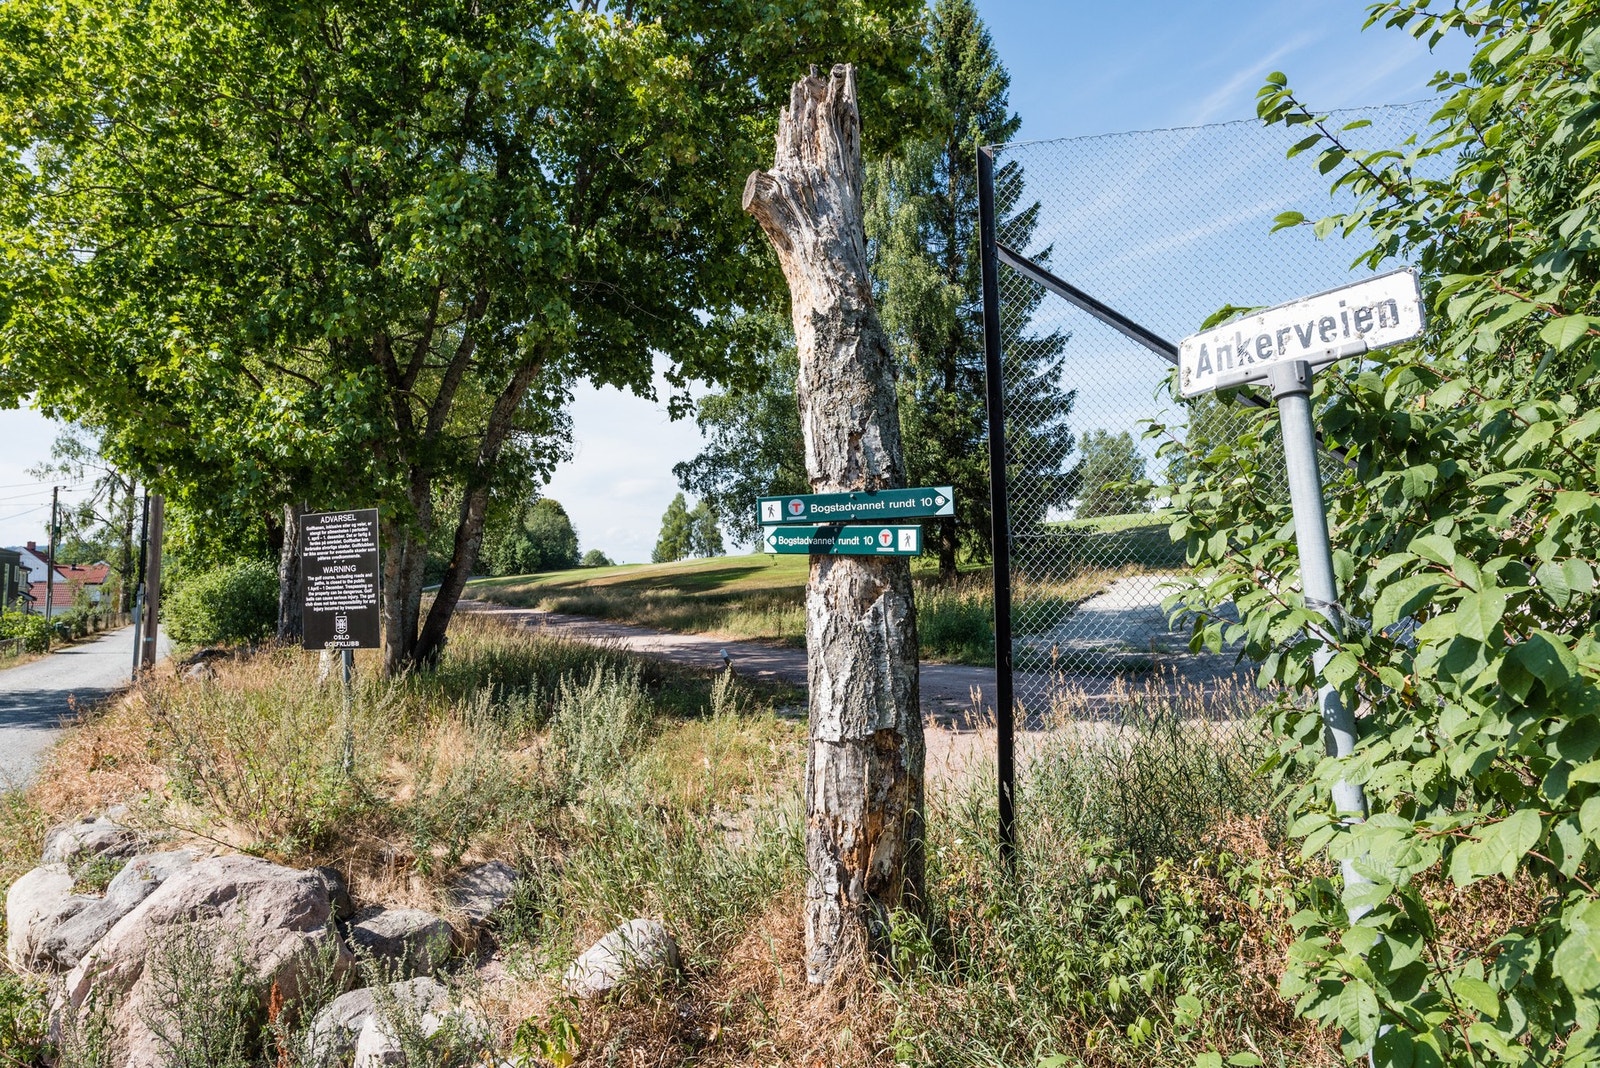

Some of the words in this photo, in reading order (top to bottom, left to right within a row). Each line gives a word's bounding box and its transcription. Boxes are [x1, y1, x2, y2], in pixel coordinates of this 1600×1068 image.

[1196, 297, 1400, 379] Ankerveien
[810, 502, 885, 515] Bogstadvannet
[889, 498, 916, 508] rundt
[920, 498, 932, 506] 10
[321, 514, 356, 523] ADVARSEL
[779, 536, 835, 546] Bogstadvannet
[838, 536, 860, 545] rundt
[864, 536, 874, 545] 10
[323, 565, 356, 573] WARNING
